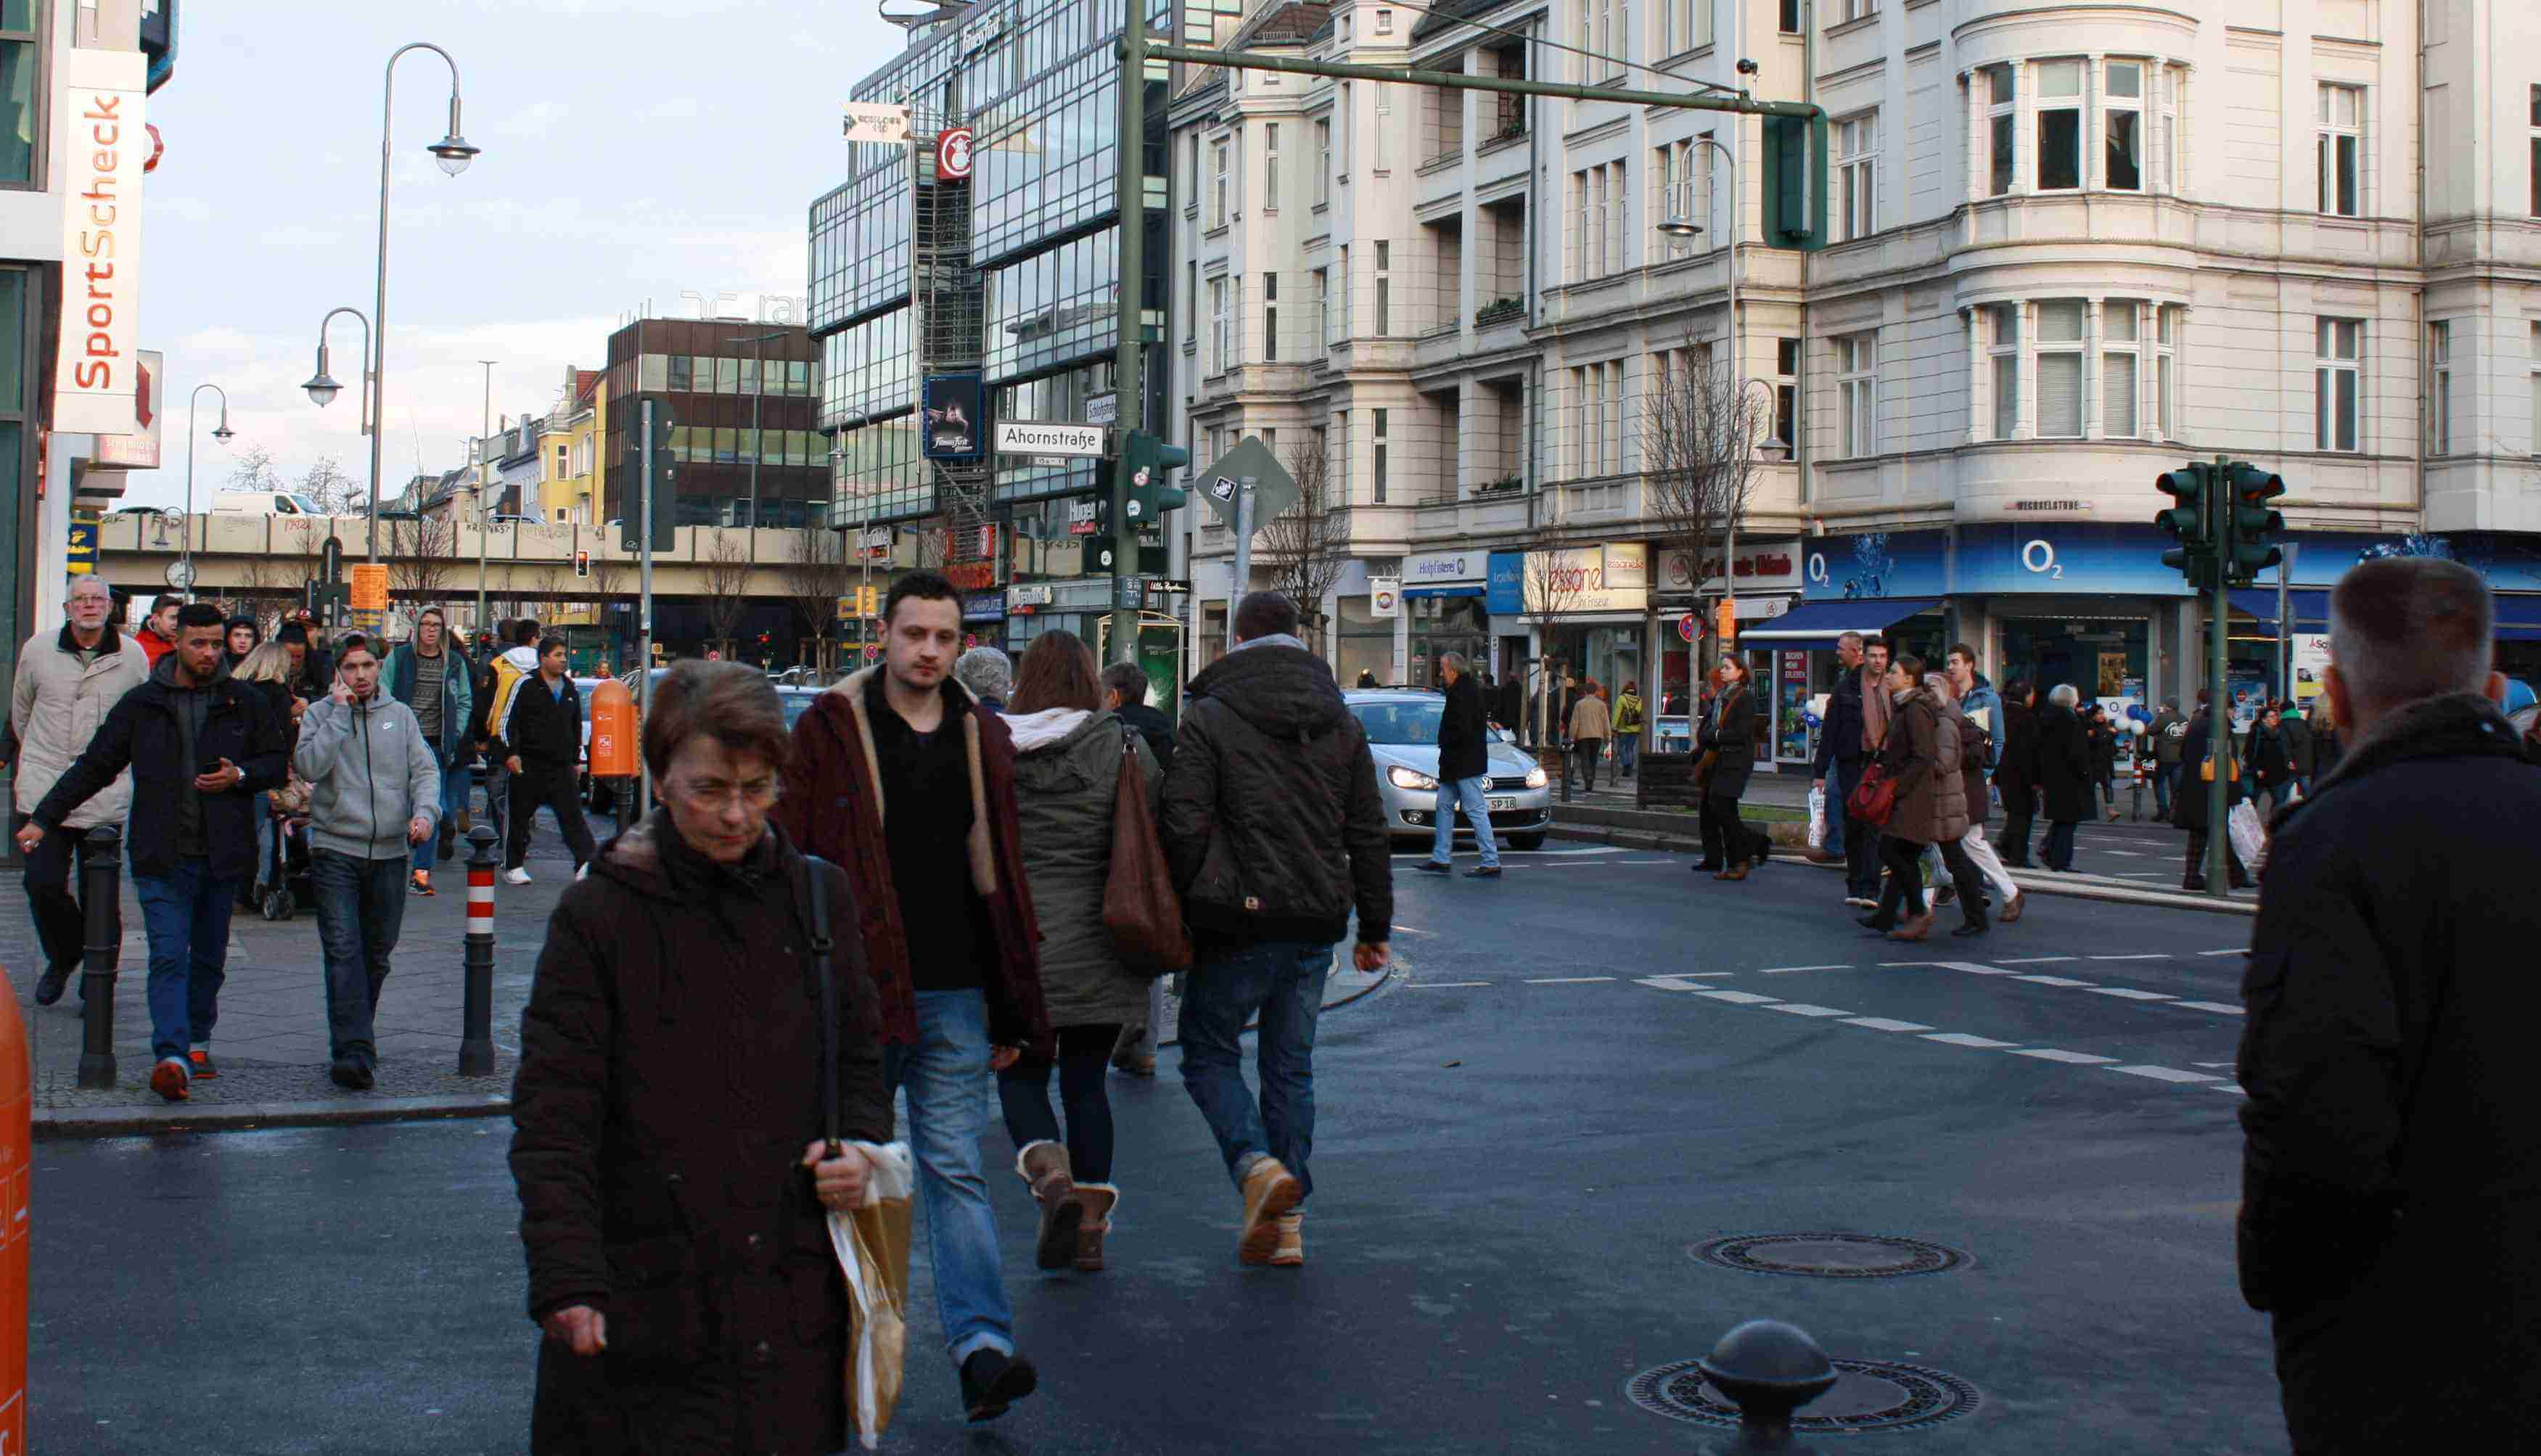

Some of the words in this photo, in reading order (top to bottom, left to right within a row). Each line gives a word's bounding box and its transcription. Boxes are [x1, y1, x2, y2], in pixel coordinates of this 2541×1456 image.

[75, 95, 120, 390] SportScheck
[1005, 427, 1096, 451] Ahornstraße
[1810, 552, 1829, 588] O2
[2021, 540, 2062, 580] O2
[1548, 567, 1603, 593] essane
